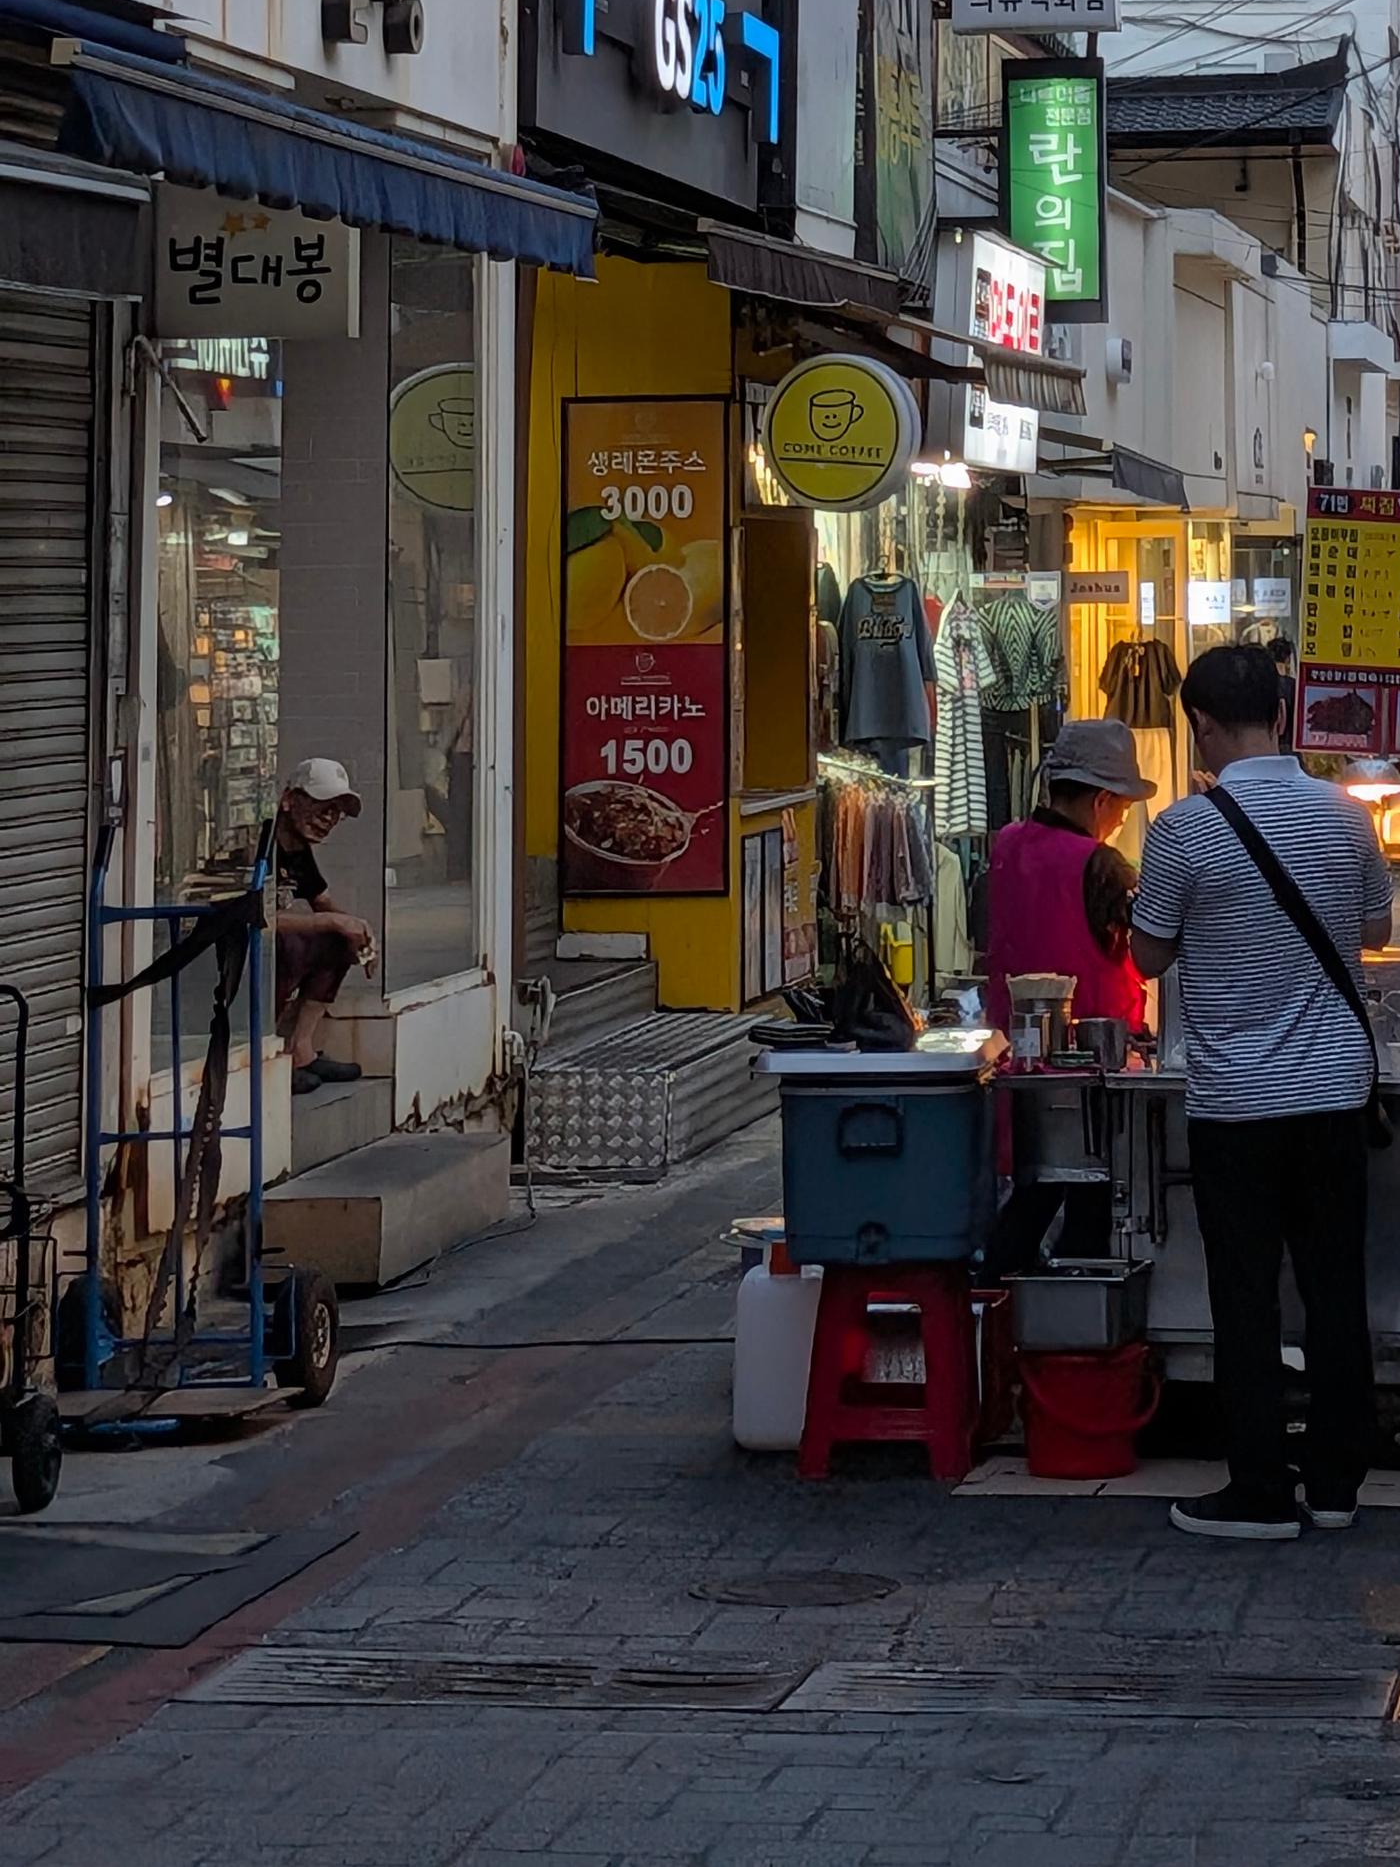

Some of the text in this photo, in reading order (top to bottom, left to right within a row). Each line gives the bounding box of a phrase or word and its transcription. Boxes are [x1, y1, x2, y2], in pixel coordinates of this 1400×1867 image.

[1028, 132, 1084, 294] 란의집
[168, 233, 333, 306] 별대봉
[586, 449, 707, 476] 생레몬주스
[600, 484, 694, 522] 3000
[585, 694, 707, 722] 아메리카노
[600, 738, 694, 776] 1500
